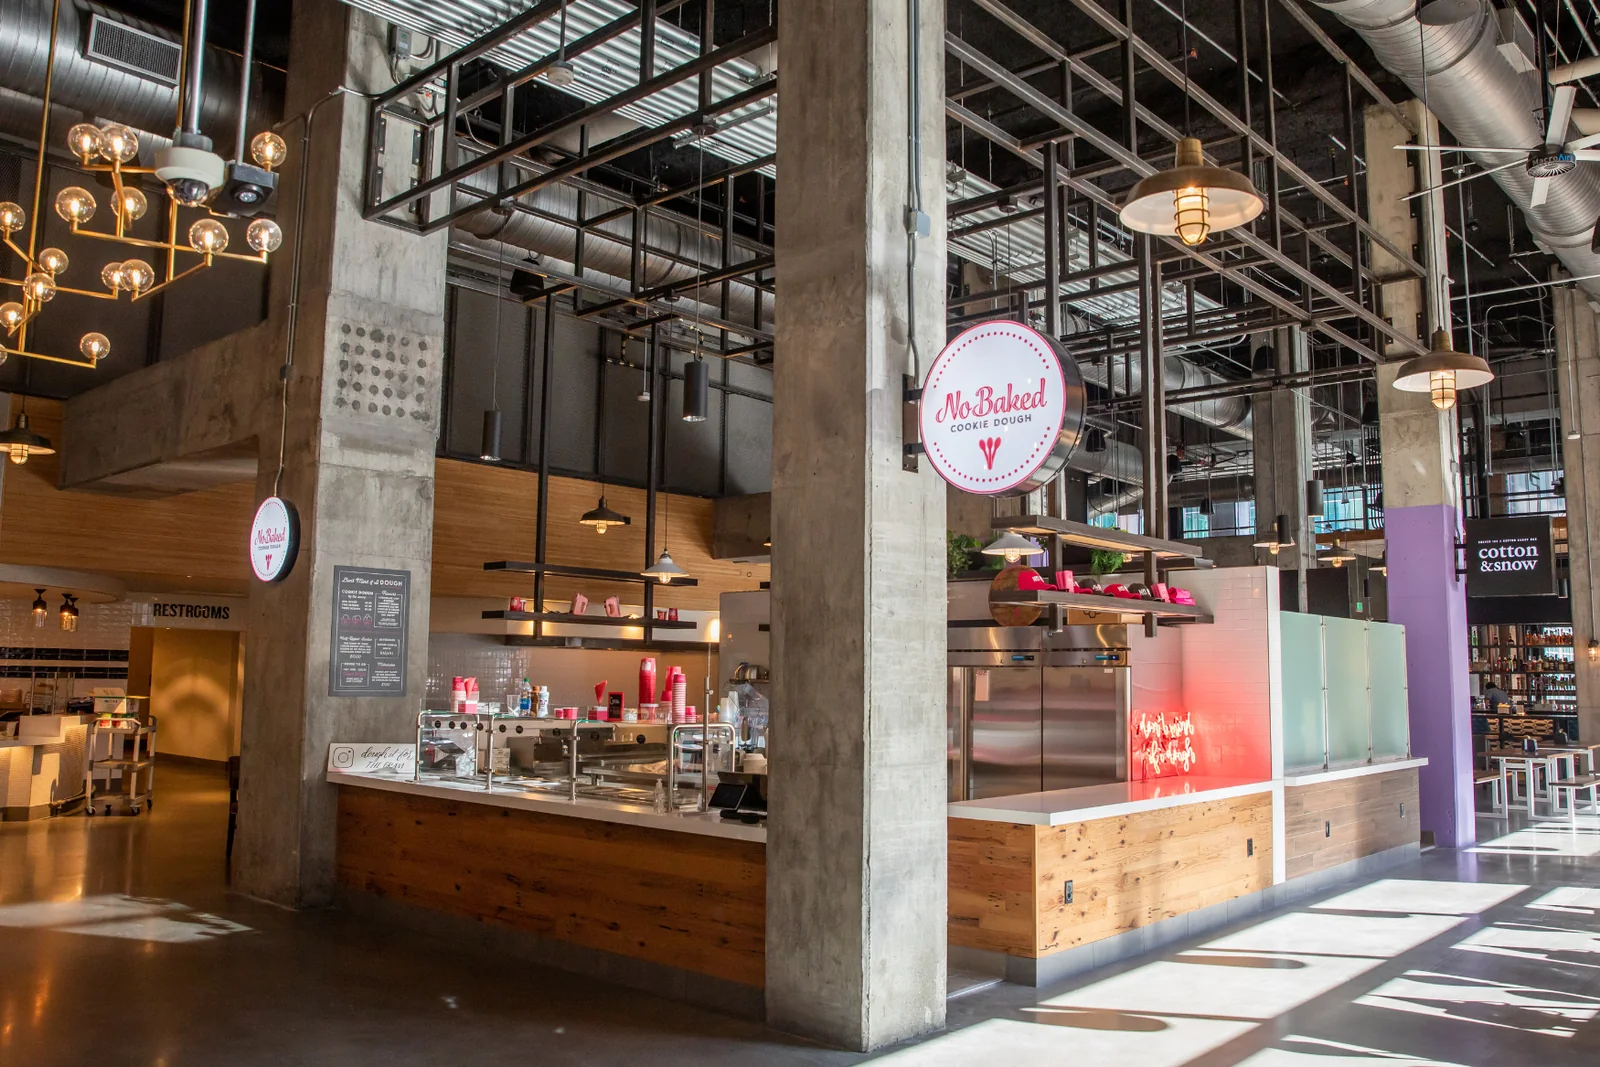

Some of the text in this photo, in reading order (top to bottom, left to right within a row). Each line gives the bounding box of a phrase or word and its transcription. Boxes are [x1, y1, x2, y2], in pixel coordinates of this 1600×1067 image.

[1532, 153, 1571, 167] MacroAir
[950, 413, 1032, 433] COOKIE DOUGH
[1478, 545, 1539, 559] cotton
[1480, 559, 1538, 572] &snow
[153, 603, 230, 619] RESTROOMS
[361, 746, 389, 762] dough
[397, 748, 414, 761] for
